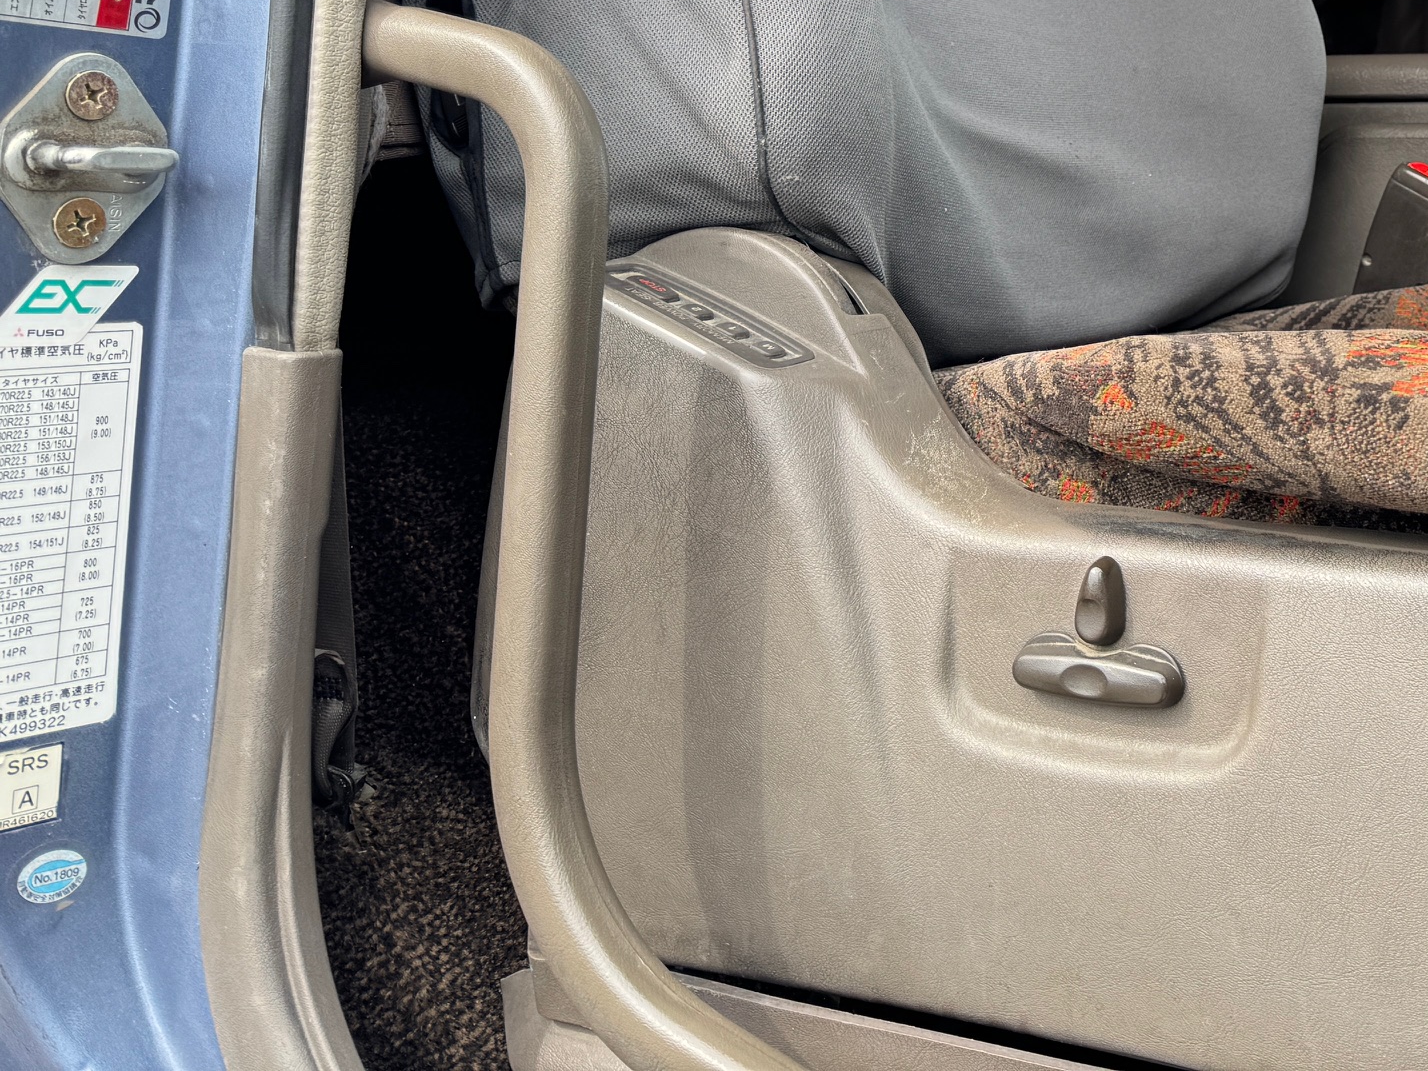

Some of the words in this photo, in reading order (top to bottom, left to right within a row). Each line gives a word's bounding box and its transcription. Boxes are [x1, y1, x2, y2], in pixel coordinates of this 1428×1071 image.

[27, 329, 64, 337] FUSO
[99, 339, 119, 348] KPa
[2, 376, 59, 387] タイヤサイズ
[92, 372, 119, 382] 空気圧
[95, 415, 109, 425] 900
[90, 474, 104, 484] 875
[88, 500, 102, 510] 850
[86, 525, 100, 535] 825
[83, 558, 97, 568] 800
[80, 596, 94, 607] 725
[78, 629, 92, 640] 700
[7, 754, 49, 775] SRS
[18, 791, 34, 809] A
[0, 810, 54, 828] R461620
